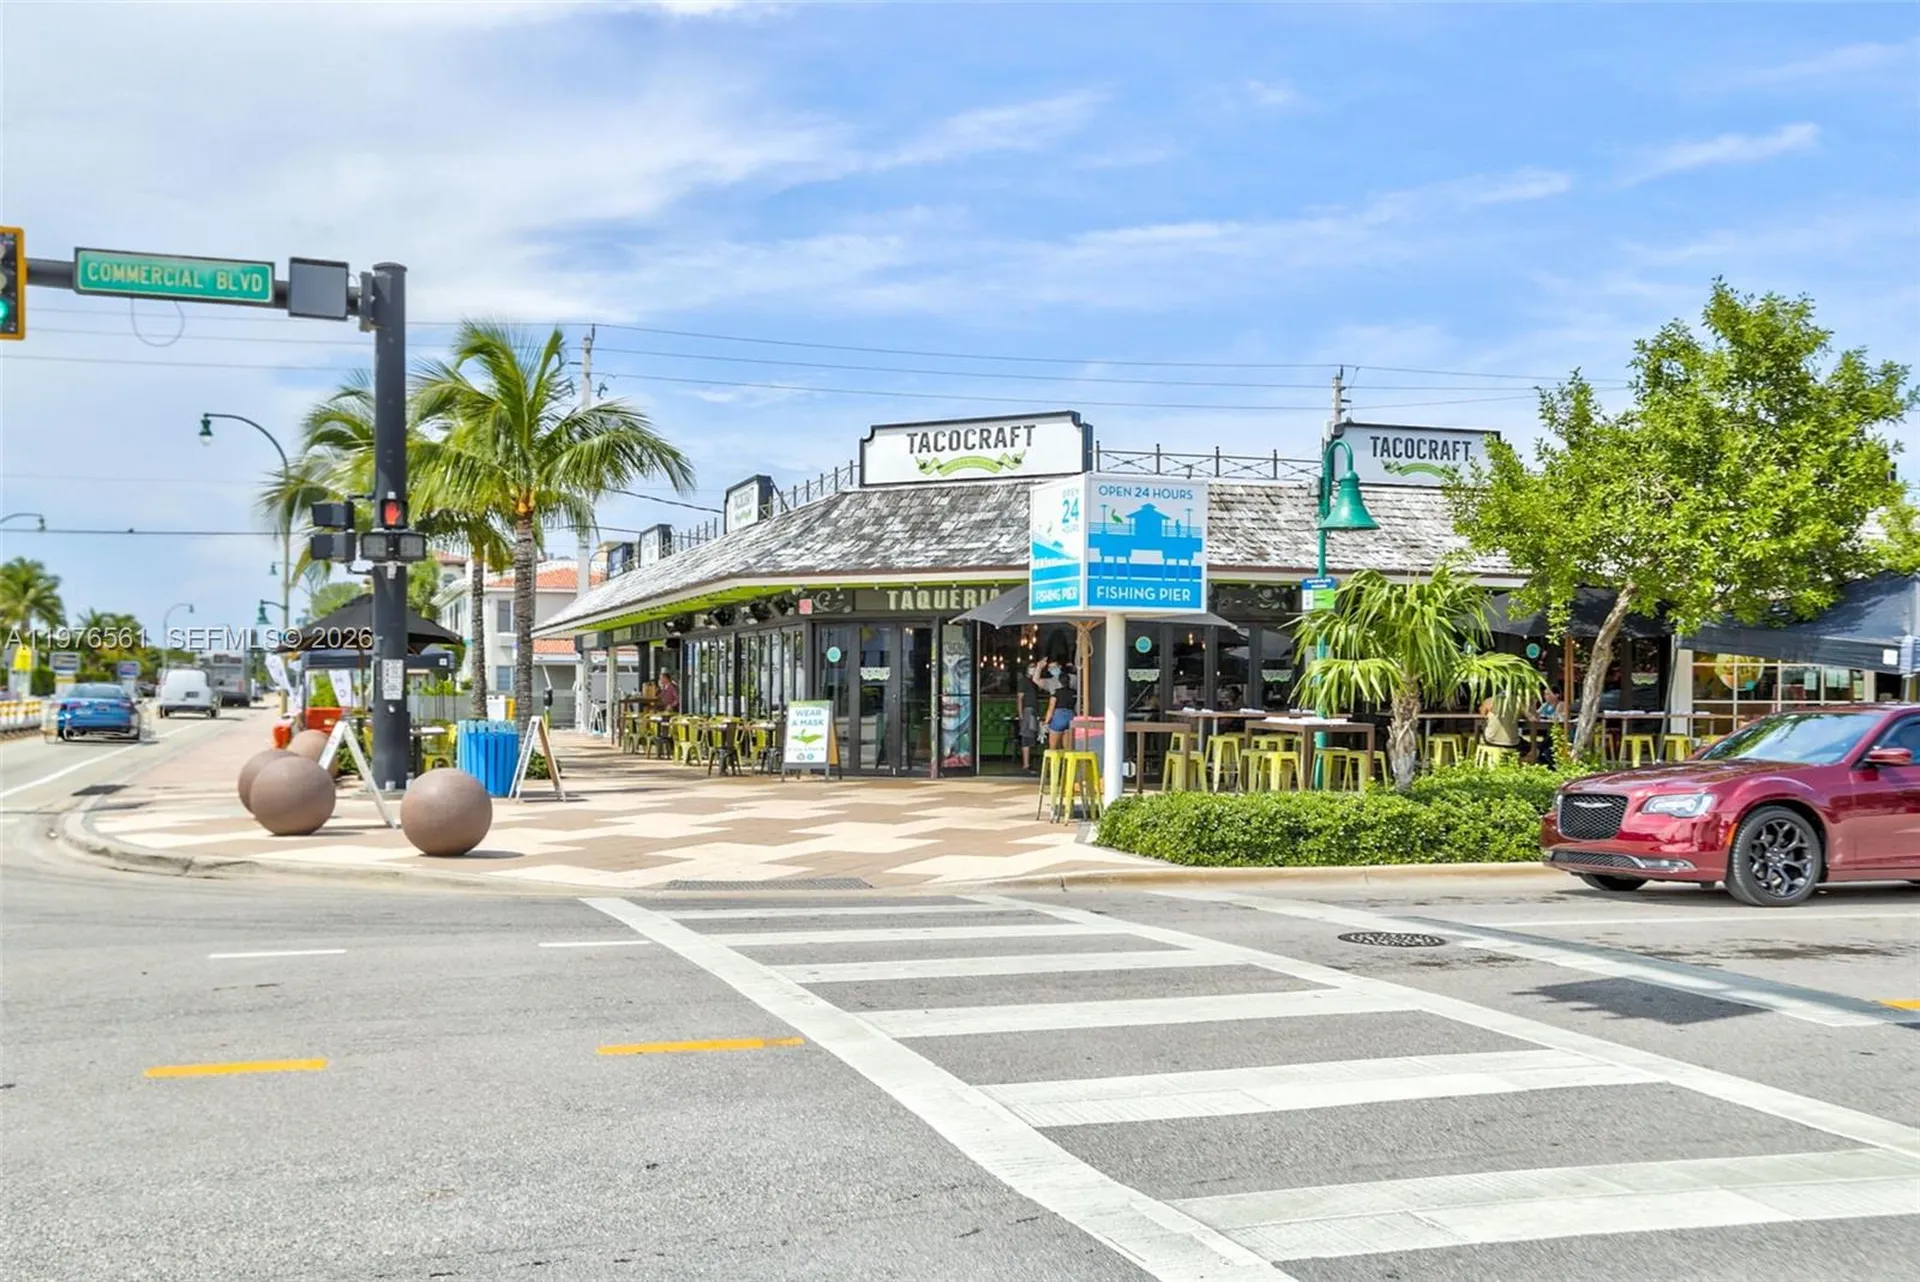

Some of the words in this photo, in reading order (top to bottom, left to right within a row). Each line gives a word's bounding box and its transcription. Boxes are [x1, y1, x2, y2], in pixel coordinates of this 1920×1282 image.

[87, 261, 204, 289] COMMERCIAL
[215, 271, 263, 293] BLVD
[906, 424, 1037, 455] TACOCRAFT
[1369, 435, 1472, 462] TACOCRAFT
[1098, 485, 1132, 498] OPEN
[1135, 486, 1150, 498] 24
[1152, 487, 1193, 500] HOURS
[1061, 497, 1080, 524] 24
[1096, 585, 1156, 601] FISHING
[1159, 587, 1191, 601] PIER
[795, 709, 823, 717] WEAR
[800, 719, 825, 727] MASK
